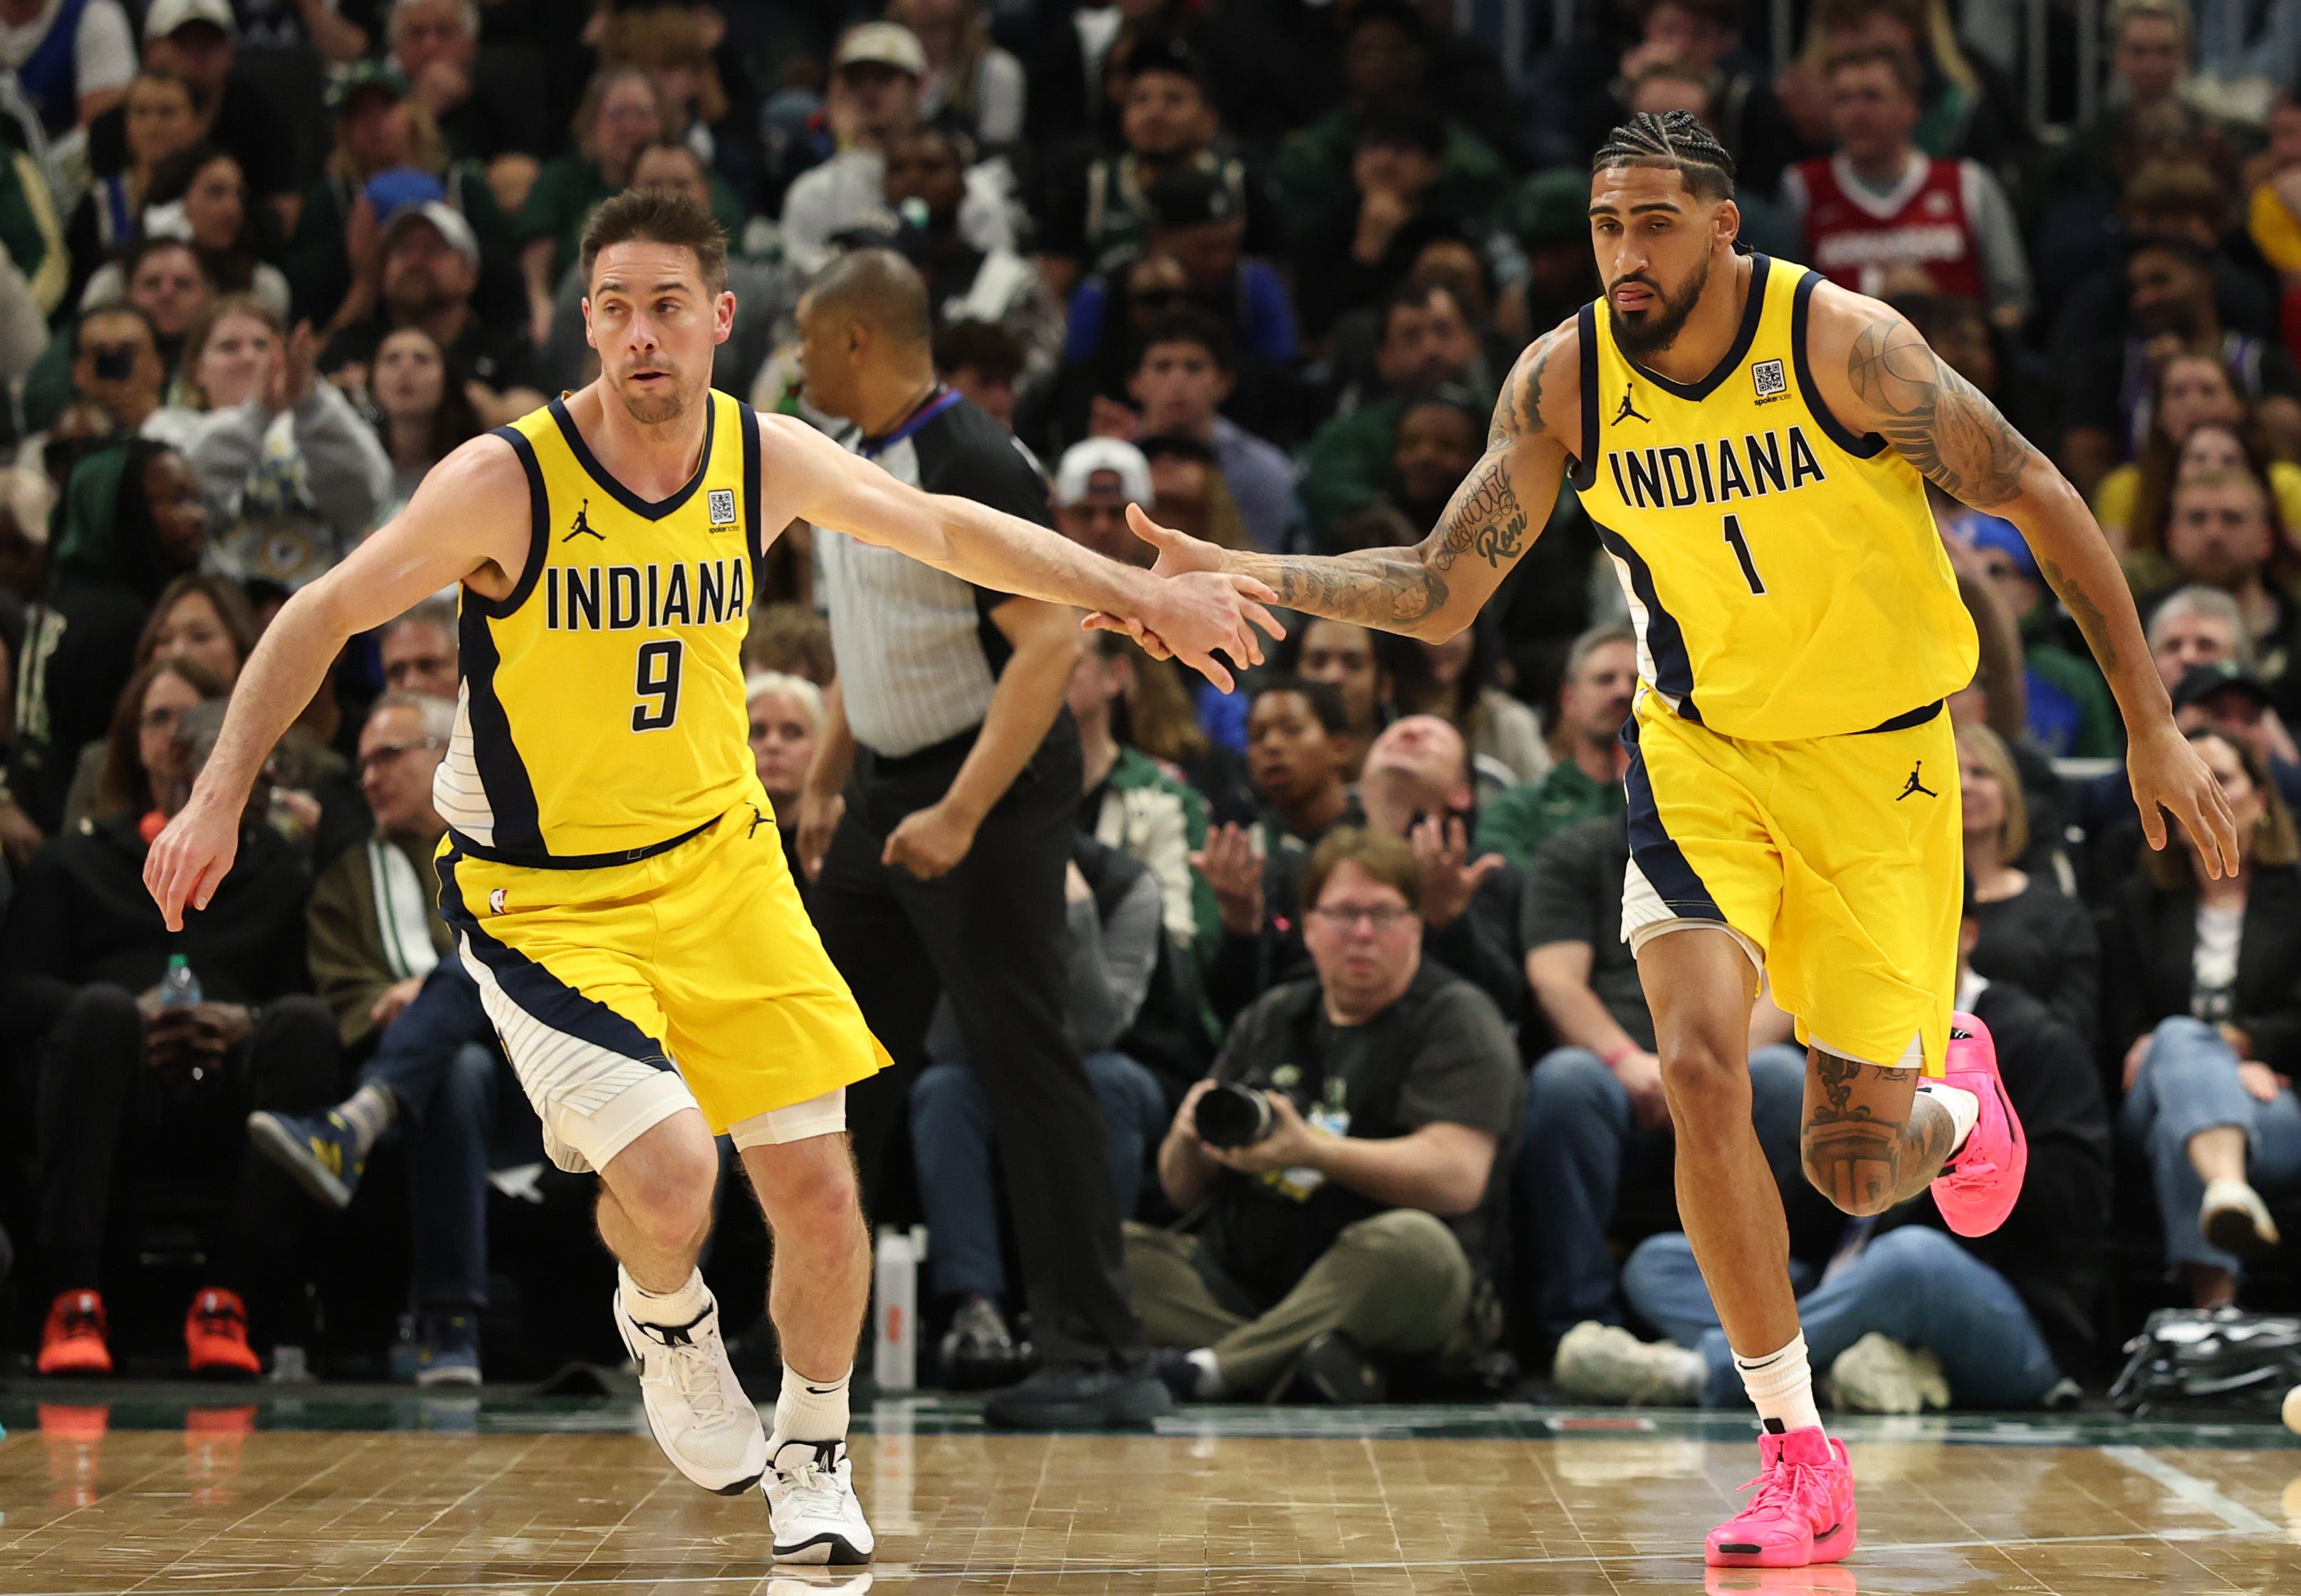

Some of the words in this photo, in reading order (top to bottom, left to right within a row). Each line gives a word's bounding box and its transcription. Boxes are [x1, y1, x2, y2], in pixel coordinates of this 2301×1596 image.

[1754, 394, 1792, 407] spokenote
[1607, 425, 1828, 510] INDIANA
[546, 556, 744, 631] INDIANA
[1721, 513, 1768, 595] 1
[631, 638, 685, 734] 9
